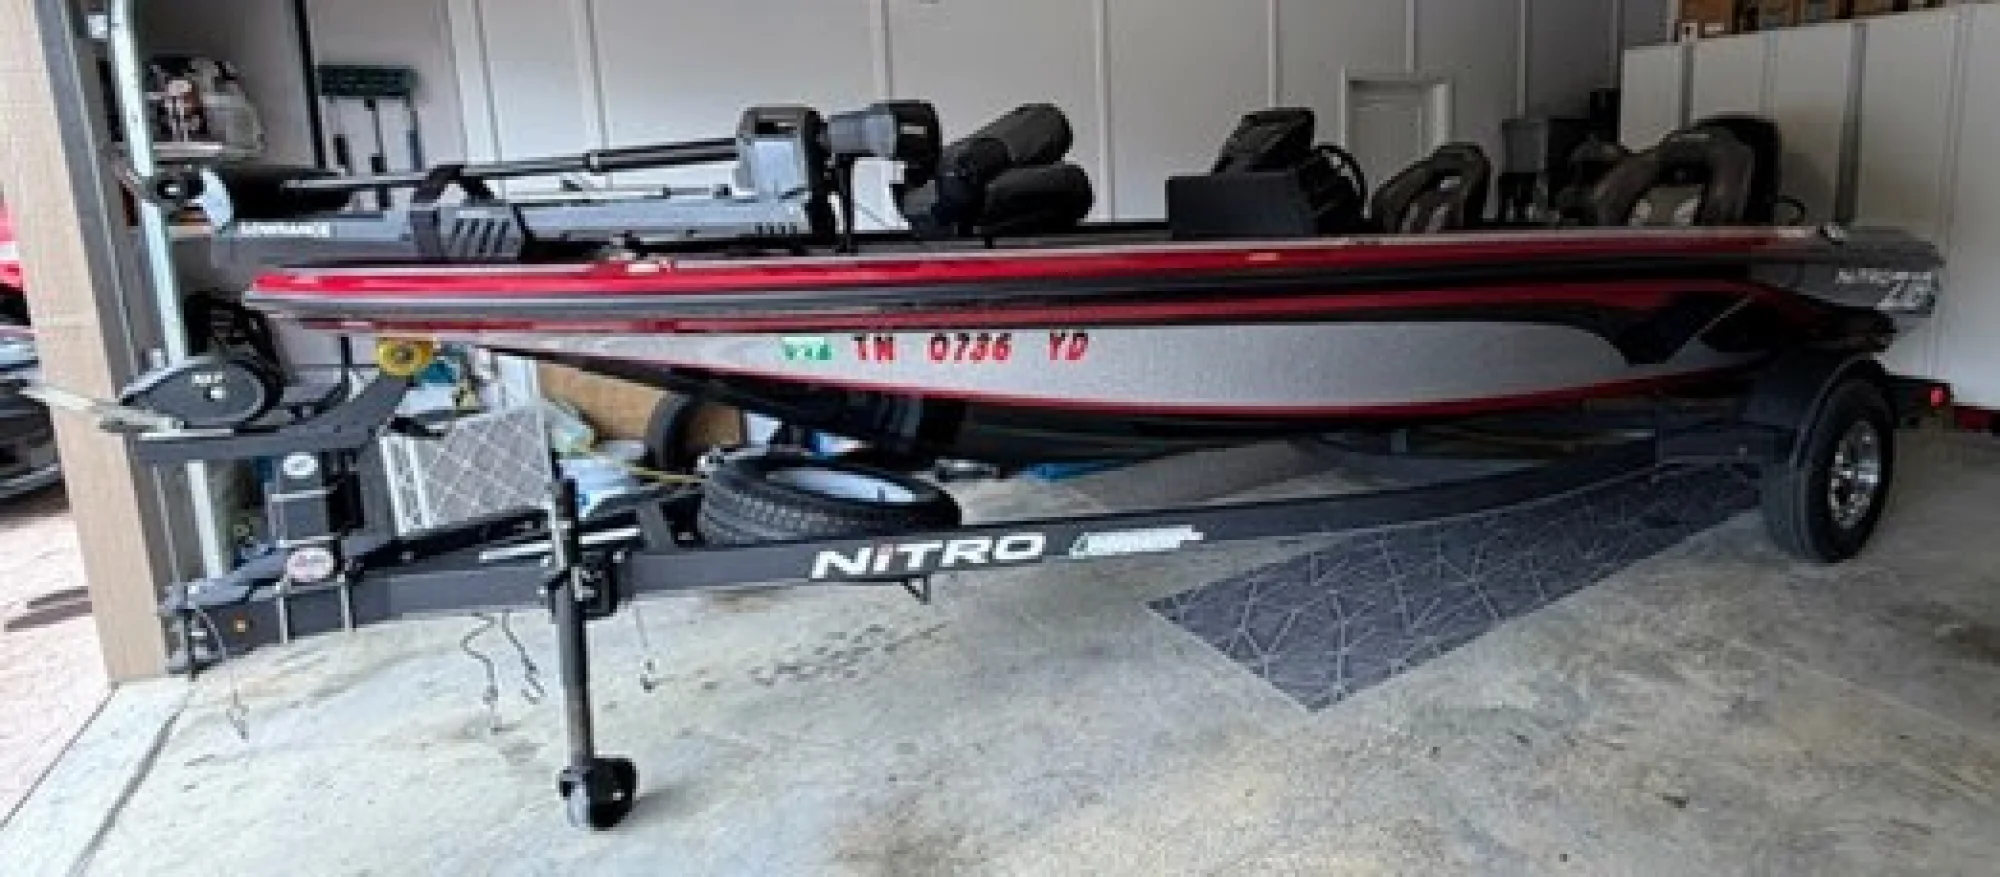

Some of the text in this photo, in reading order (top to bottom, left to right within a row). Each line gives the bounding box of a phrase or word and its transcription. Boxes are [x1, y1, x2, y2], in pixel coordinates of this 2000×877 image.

[851, 331, 897, 362] TN
[929, 331, 1013, 362] 0736
[1048, 330, 1090, 362] YD
